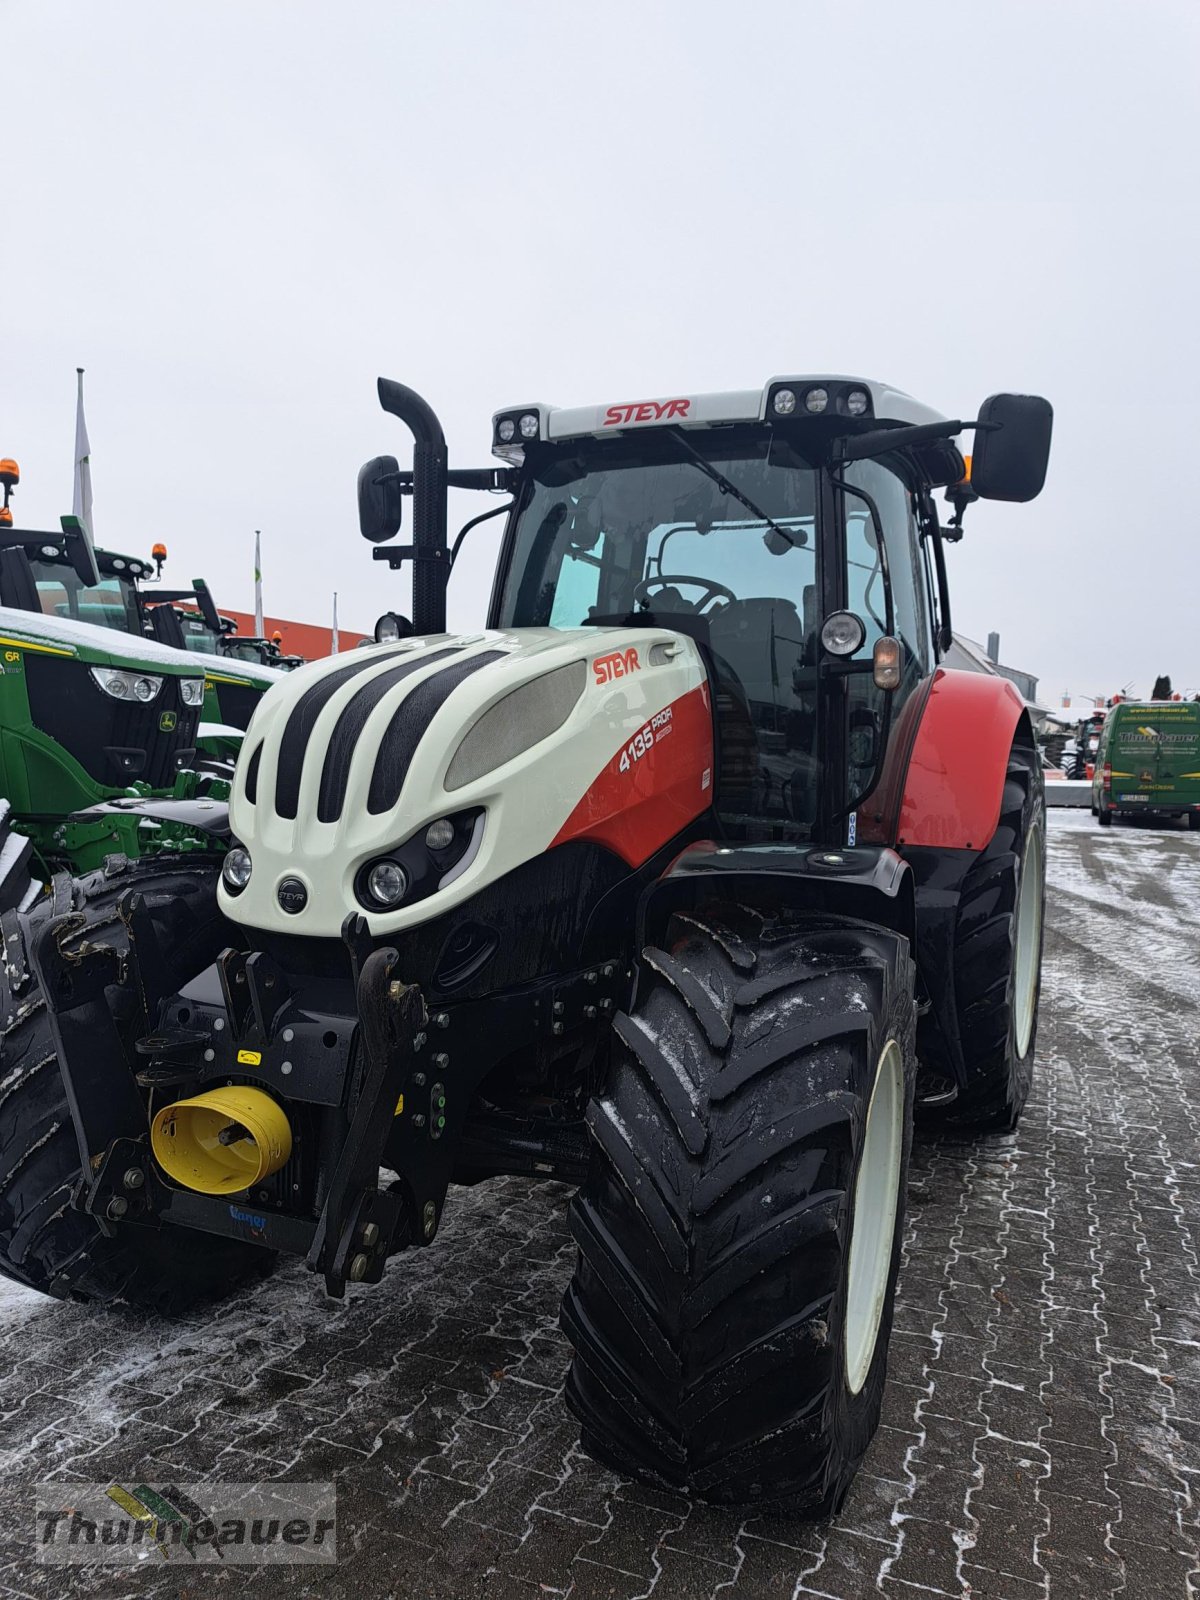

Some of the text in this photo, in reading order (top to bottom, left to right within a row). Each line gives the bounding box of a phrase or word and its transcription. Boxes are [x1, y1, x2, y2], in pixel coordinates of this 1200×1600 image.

[603, 399, 691, 426] STEYR
[5, 651, 20, 662] 6R
[593, 647, 642, 685] STEYR
[619, 725, 654, 773] 4135
[278, 890, 305, 901] STEYR
